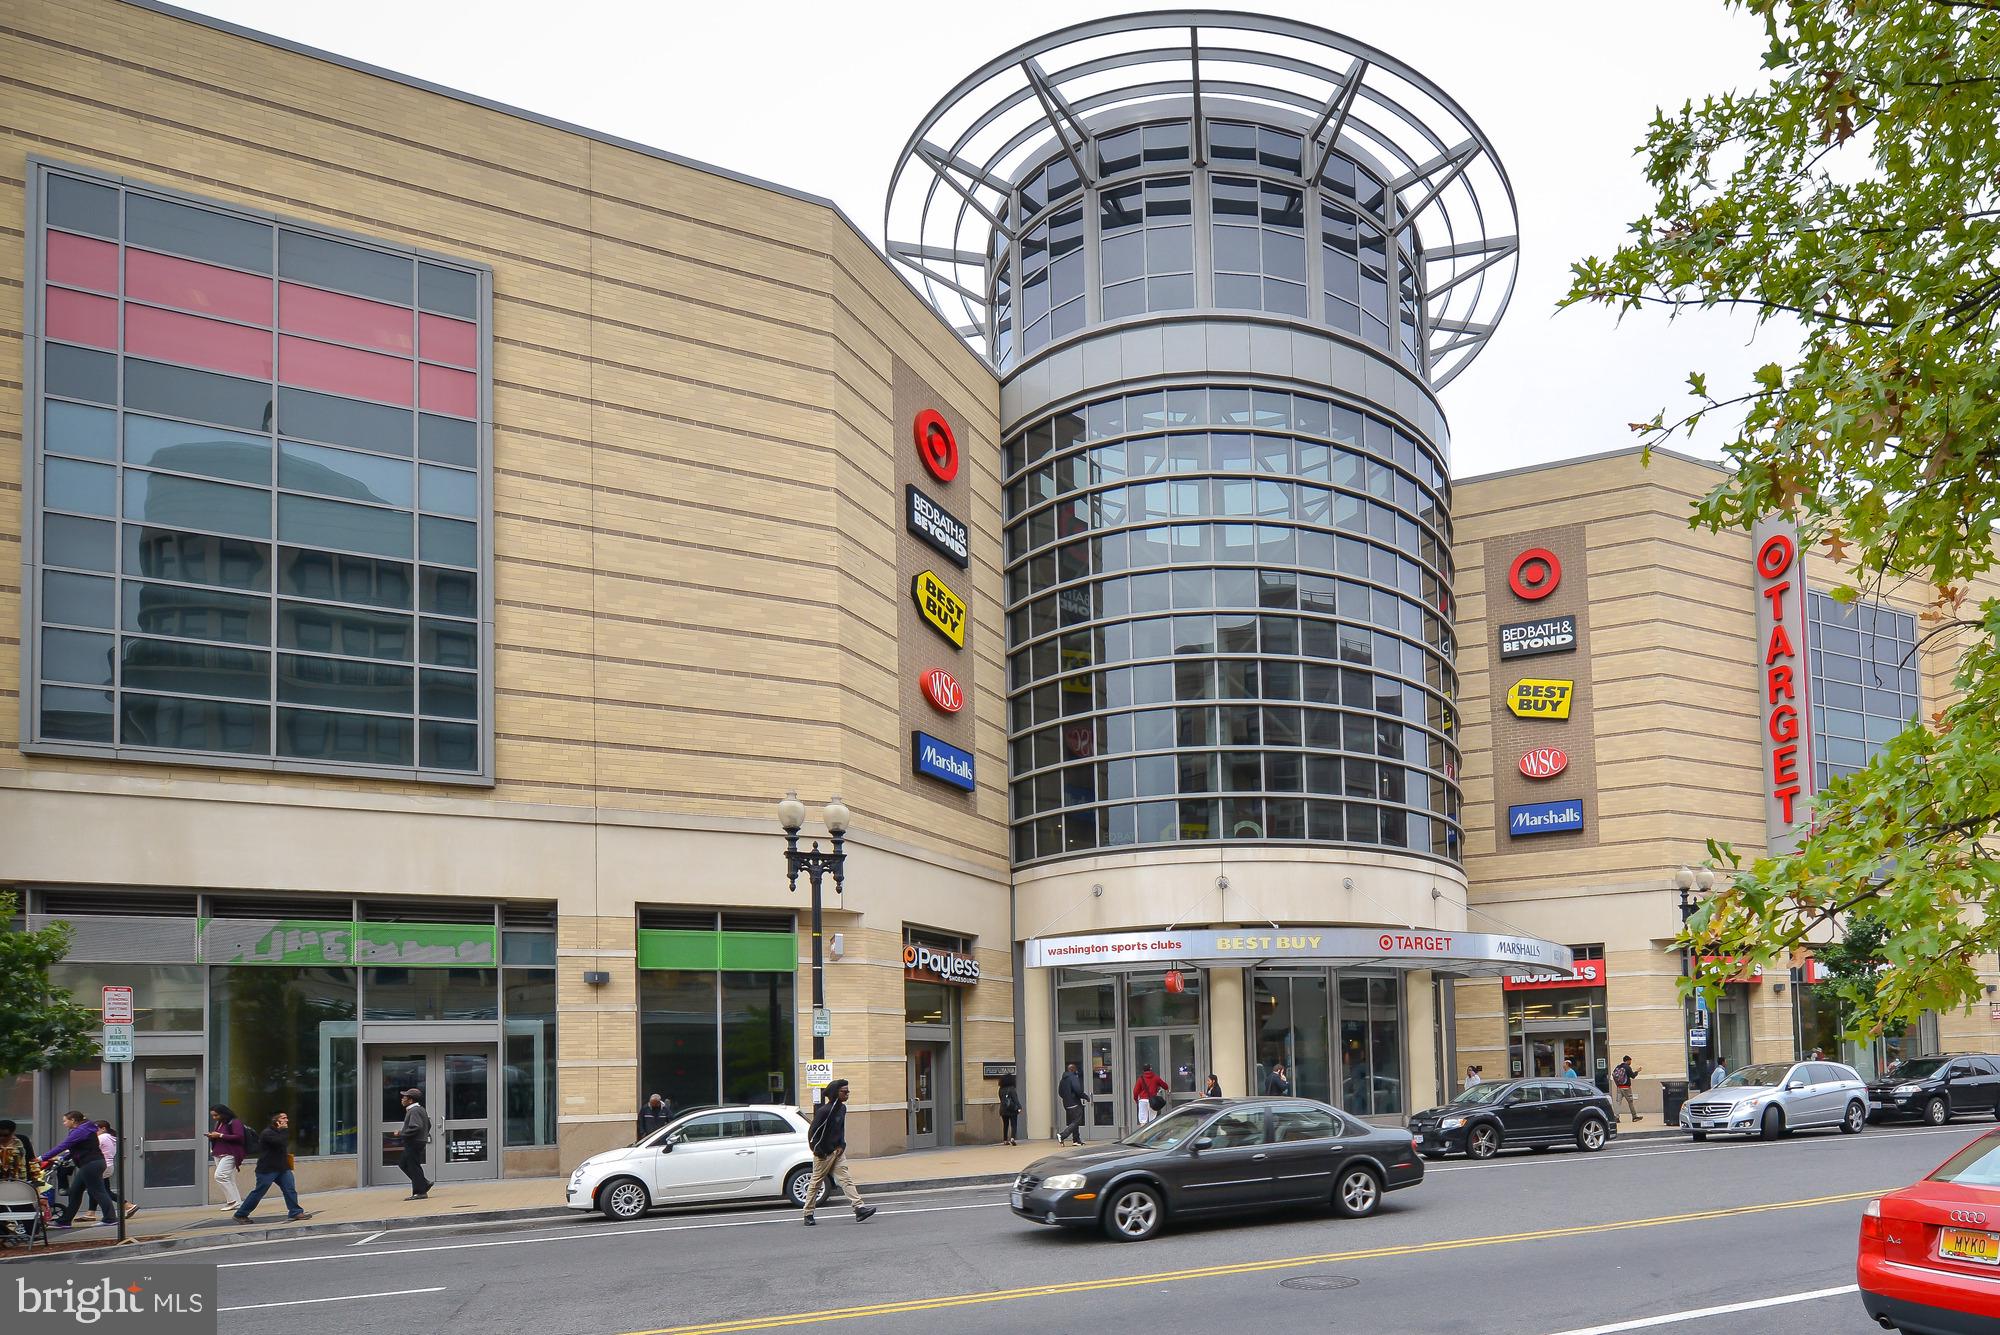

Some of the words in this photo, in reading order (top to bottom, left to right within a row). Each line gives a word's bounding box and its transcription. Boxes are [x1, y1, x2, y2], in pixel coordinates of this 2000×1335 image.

[914, 493, 933, 519] BED
[933, 508, 958, 540] BATH
[959, 528, 967, 546] &
[914, 510, 967, 557] BEYOND
[926, 576, 964, 622] BEST
[926, 598, 960, 633] BUY
[1502, 628, 1527, 642] BED
[1527, 622, 1560, 638] BATH
[1561, 620, 1573, 633] &
[1503, 634, 1574, 652] BEYOND
[931, 671, 960, 708] WSC
[1517, 685, 1570, 698] BEST
[1517, 699, 1563, 712] BUY
[1763, 581, 1800, 824] TARGET
[922, 745, 973, 781] Marshalls
[1524, 749, 1561, 775] WSC
[1512, 808, 1580, 828] Marshalls
[1047, 944, 1109, 956] washington
[1111, 941, 1148, 953] sports
[1150, 940, 1182, 950] clubs
[1215, 936, 1272, 950] BEST
[1275, 935, 1323, 949] BUY
[1395, 936, 1452, 951] TARGET
[1496, 941, 1541, 957] MARSHALLS
[918, 947, 980, 979] Payless
[1887, 1234, 1902, 1245] A4
